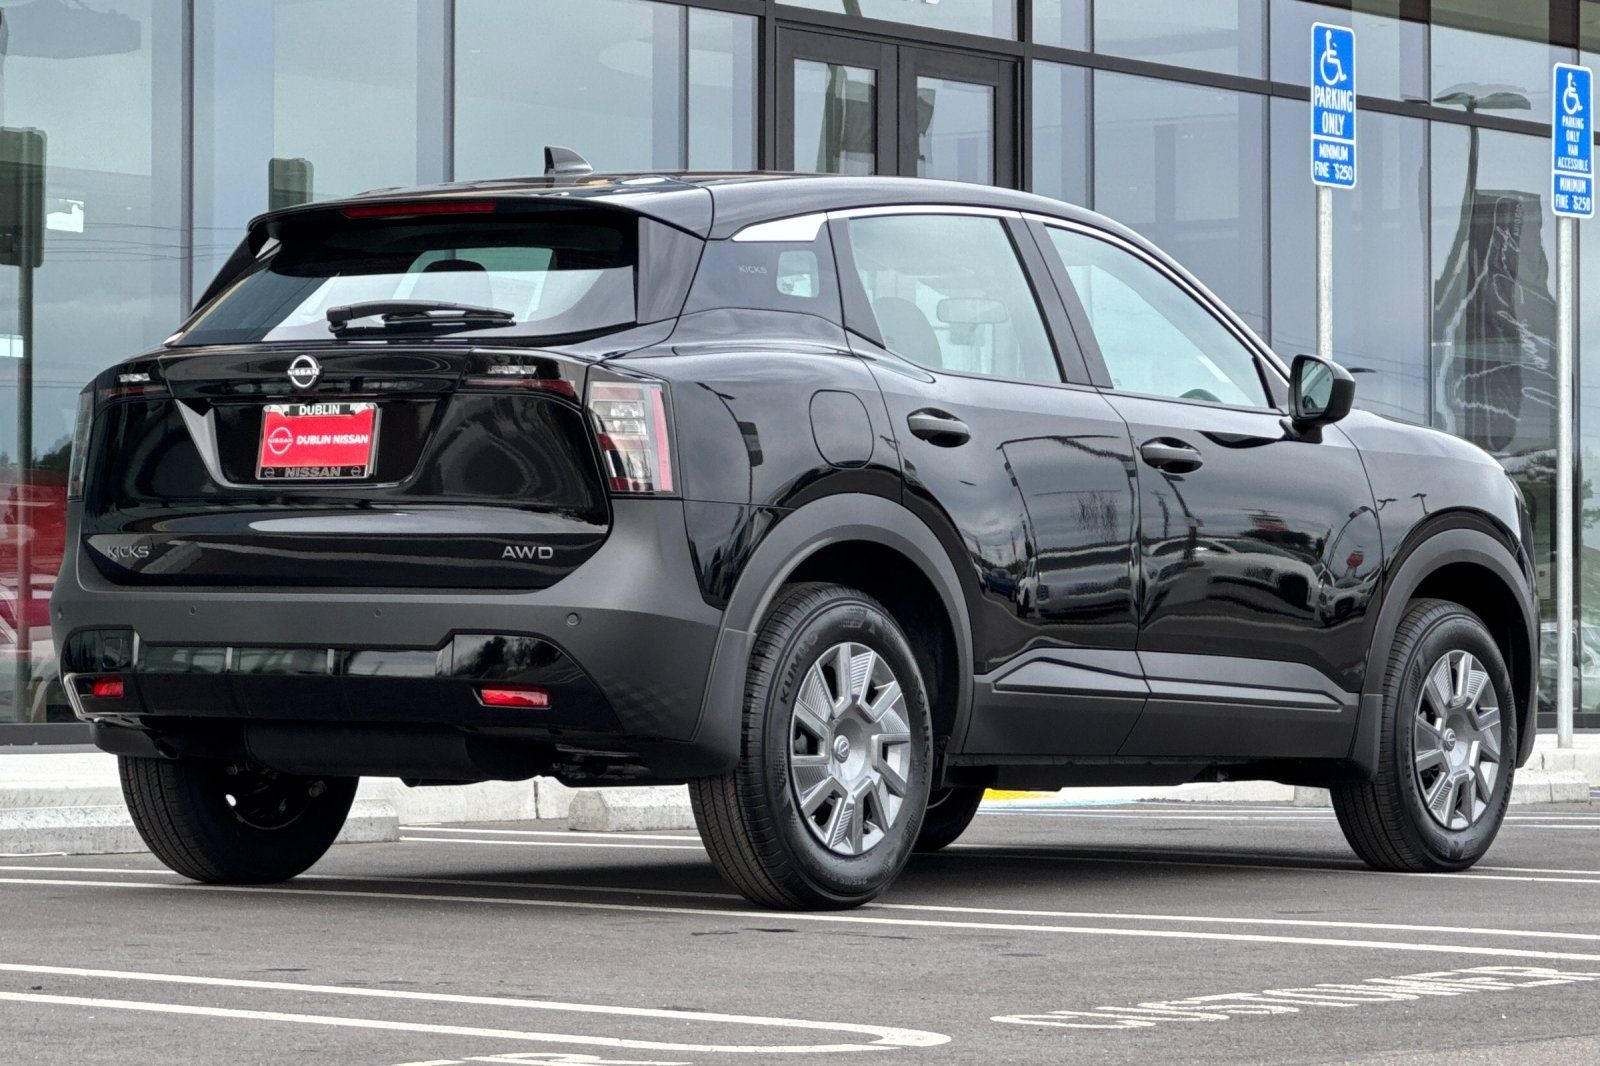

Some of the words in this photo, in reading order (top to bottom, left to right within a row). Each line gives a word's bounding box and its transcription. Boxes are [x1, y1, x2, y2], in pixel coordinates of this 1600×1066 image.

[1314, 85, 1353, 113] PARKING
[1322, 112, 1345, 135] ONLY
[1561, 115, 1584, 130] PARKING
[1565, 130, 1580, 143] ONLY
[1319, 143, 1348, 161] MINIMUM
[1314, 161, 1330, 178] FINE
[1557, 157, 1588, 172] ACCESSIBLE
[1560, 177, 1586, 193] MINIMUM
[1555, 194, 1569, 209] FINE
[739, 265, 767, 273] KICKS
[287, 368, 319, 376] NISSAN
[299, 404, 340, 416] DUBLIN
[296, 435, 331, 445] DUBLIN
[333, 434, 369, 444] NISSAN
[284, 466, 341, 478] NISSAN
[106, 545, 150, 559] KICKS
[501, 545, 554, 560] AWD
[990, 966, 1600, 1029] CUSTOMER
